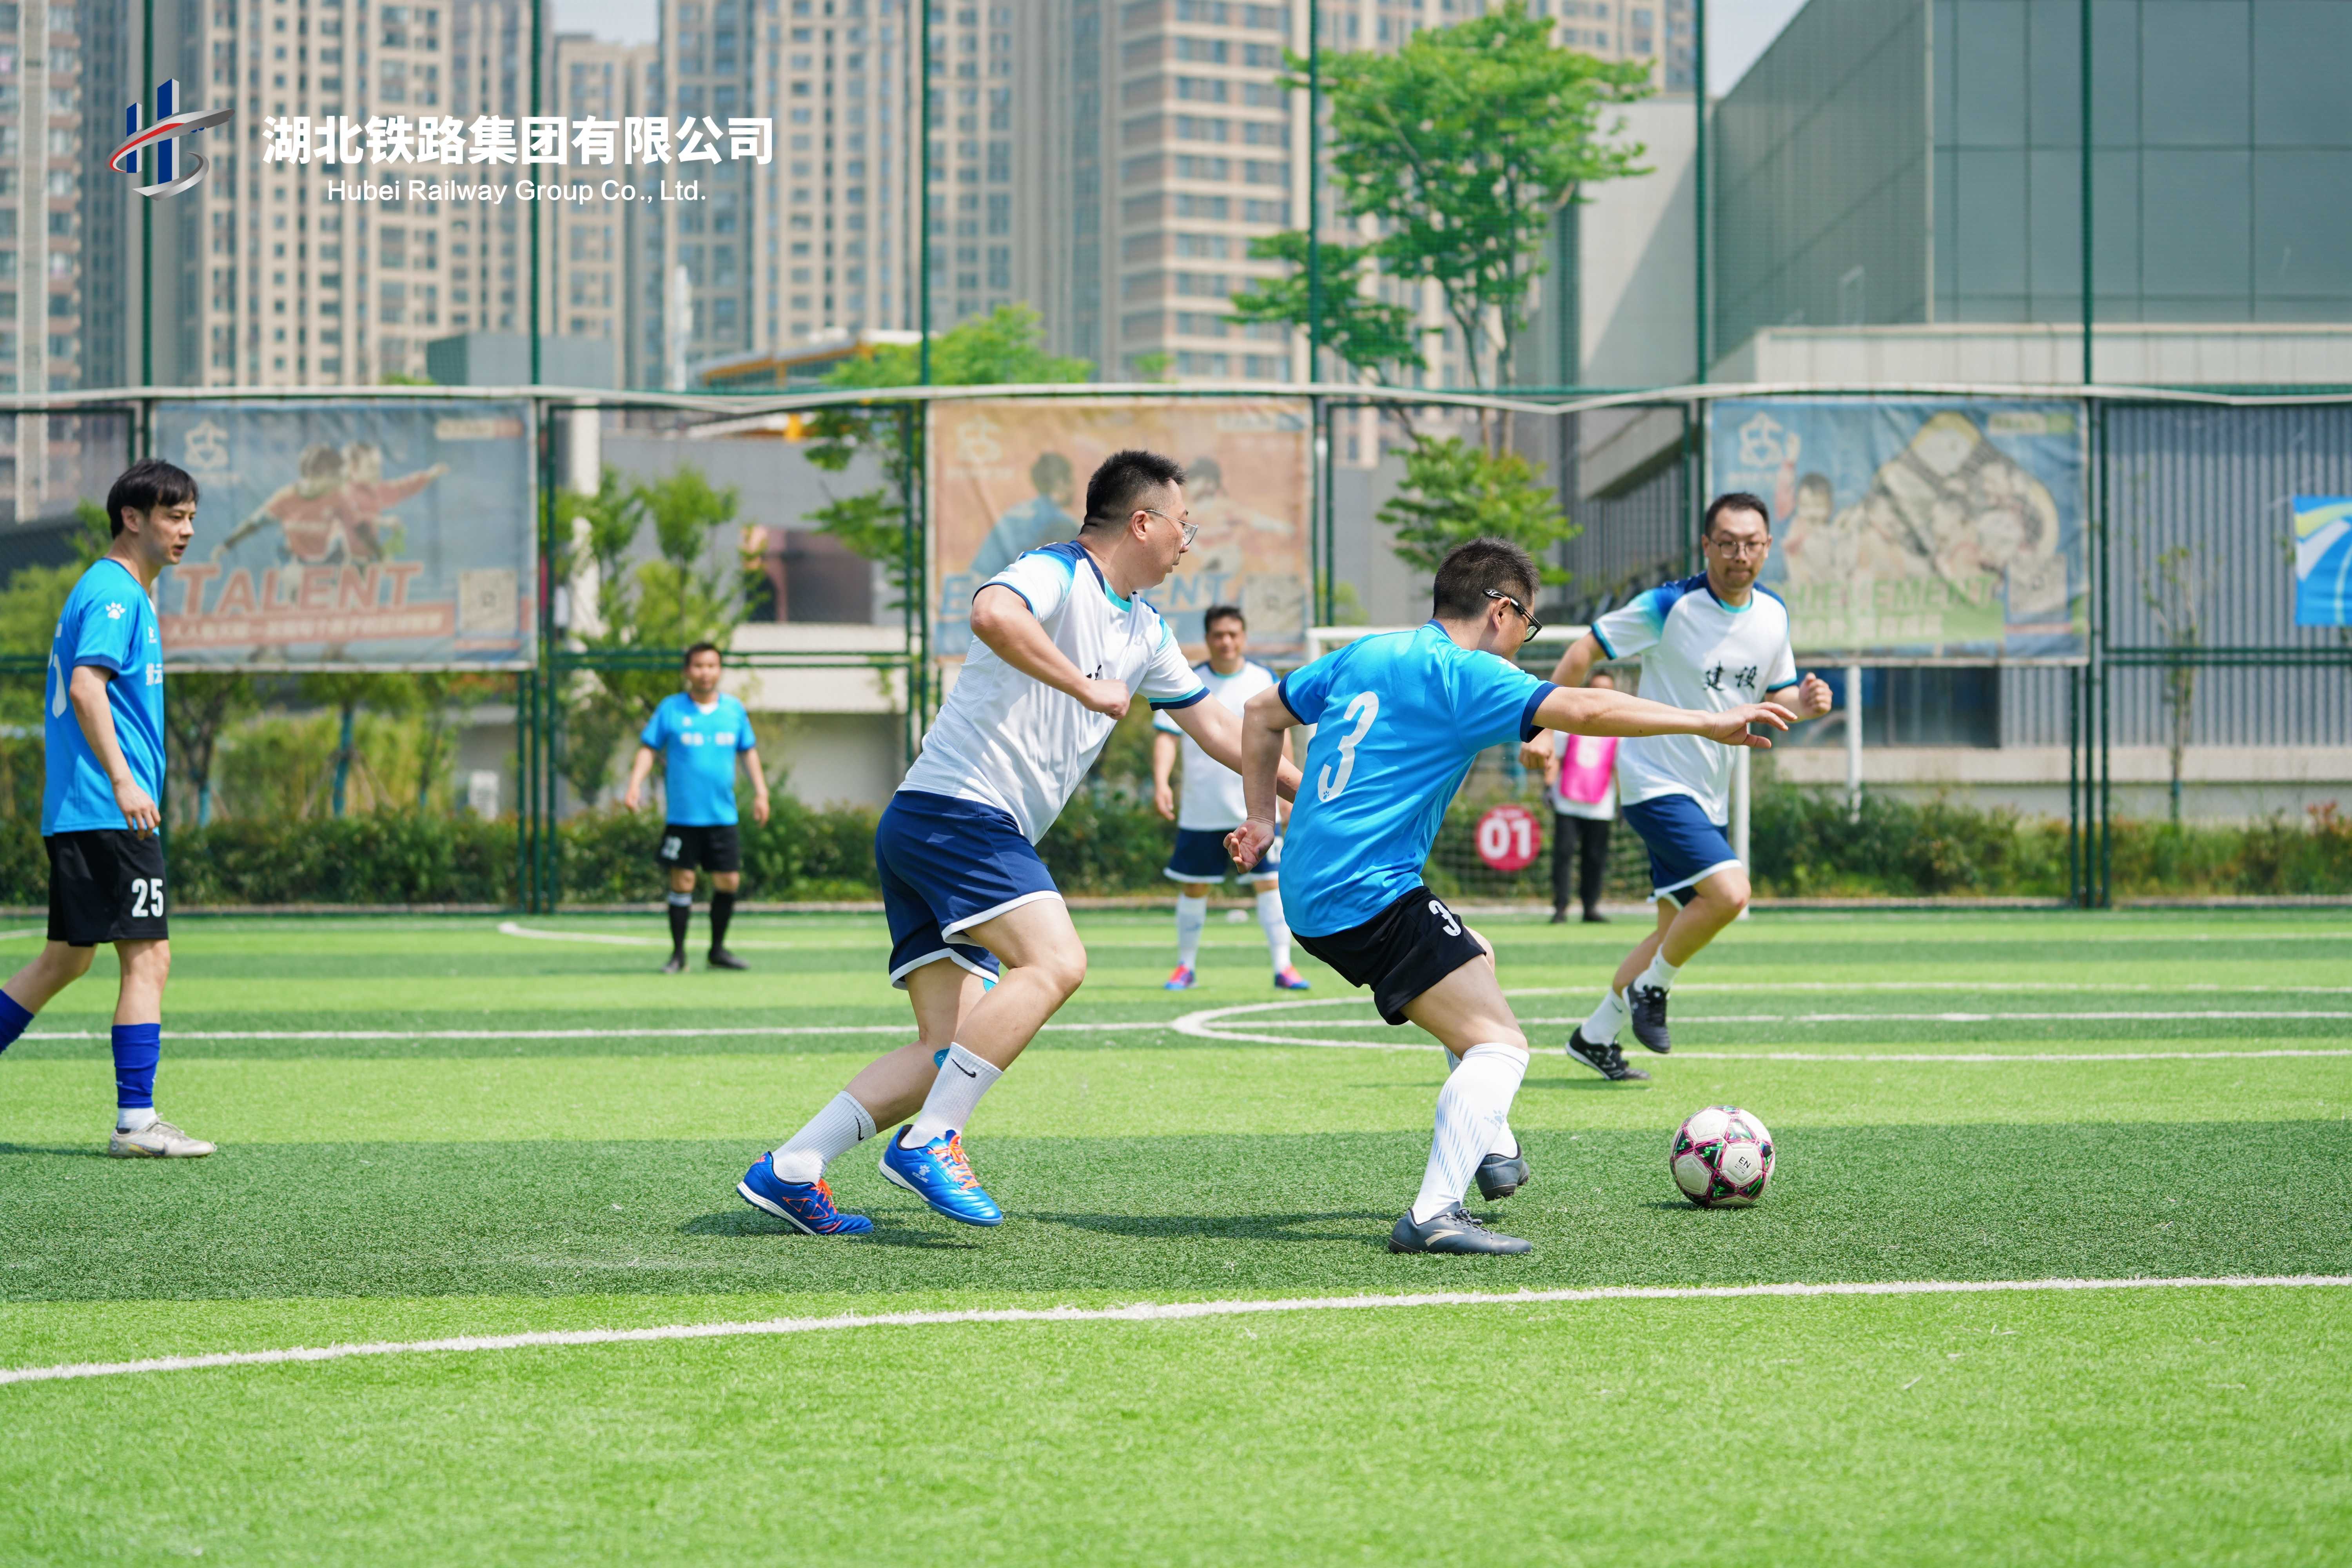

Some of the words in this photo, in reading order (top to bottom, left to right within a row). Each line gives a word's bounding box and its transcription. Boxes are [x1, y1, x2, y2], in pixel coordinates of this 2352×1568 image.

[172, 562, 423, 617] TALENT
[1702, 660, 1757, 690] 建设
[1318, 691, 1379, 802] 3
[1480, 818, 1532, 859] 01
[131, 878, 164, 917] 25
[1428, 900, 1461, 936] 3
[1739, 1156, 1751, 1169] EN
